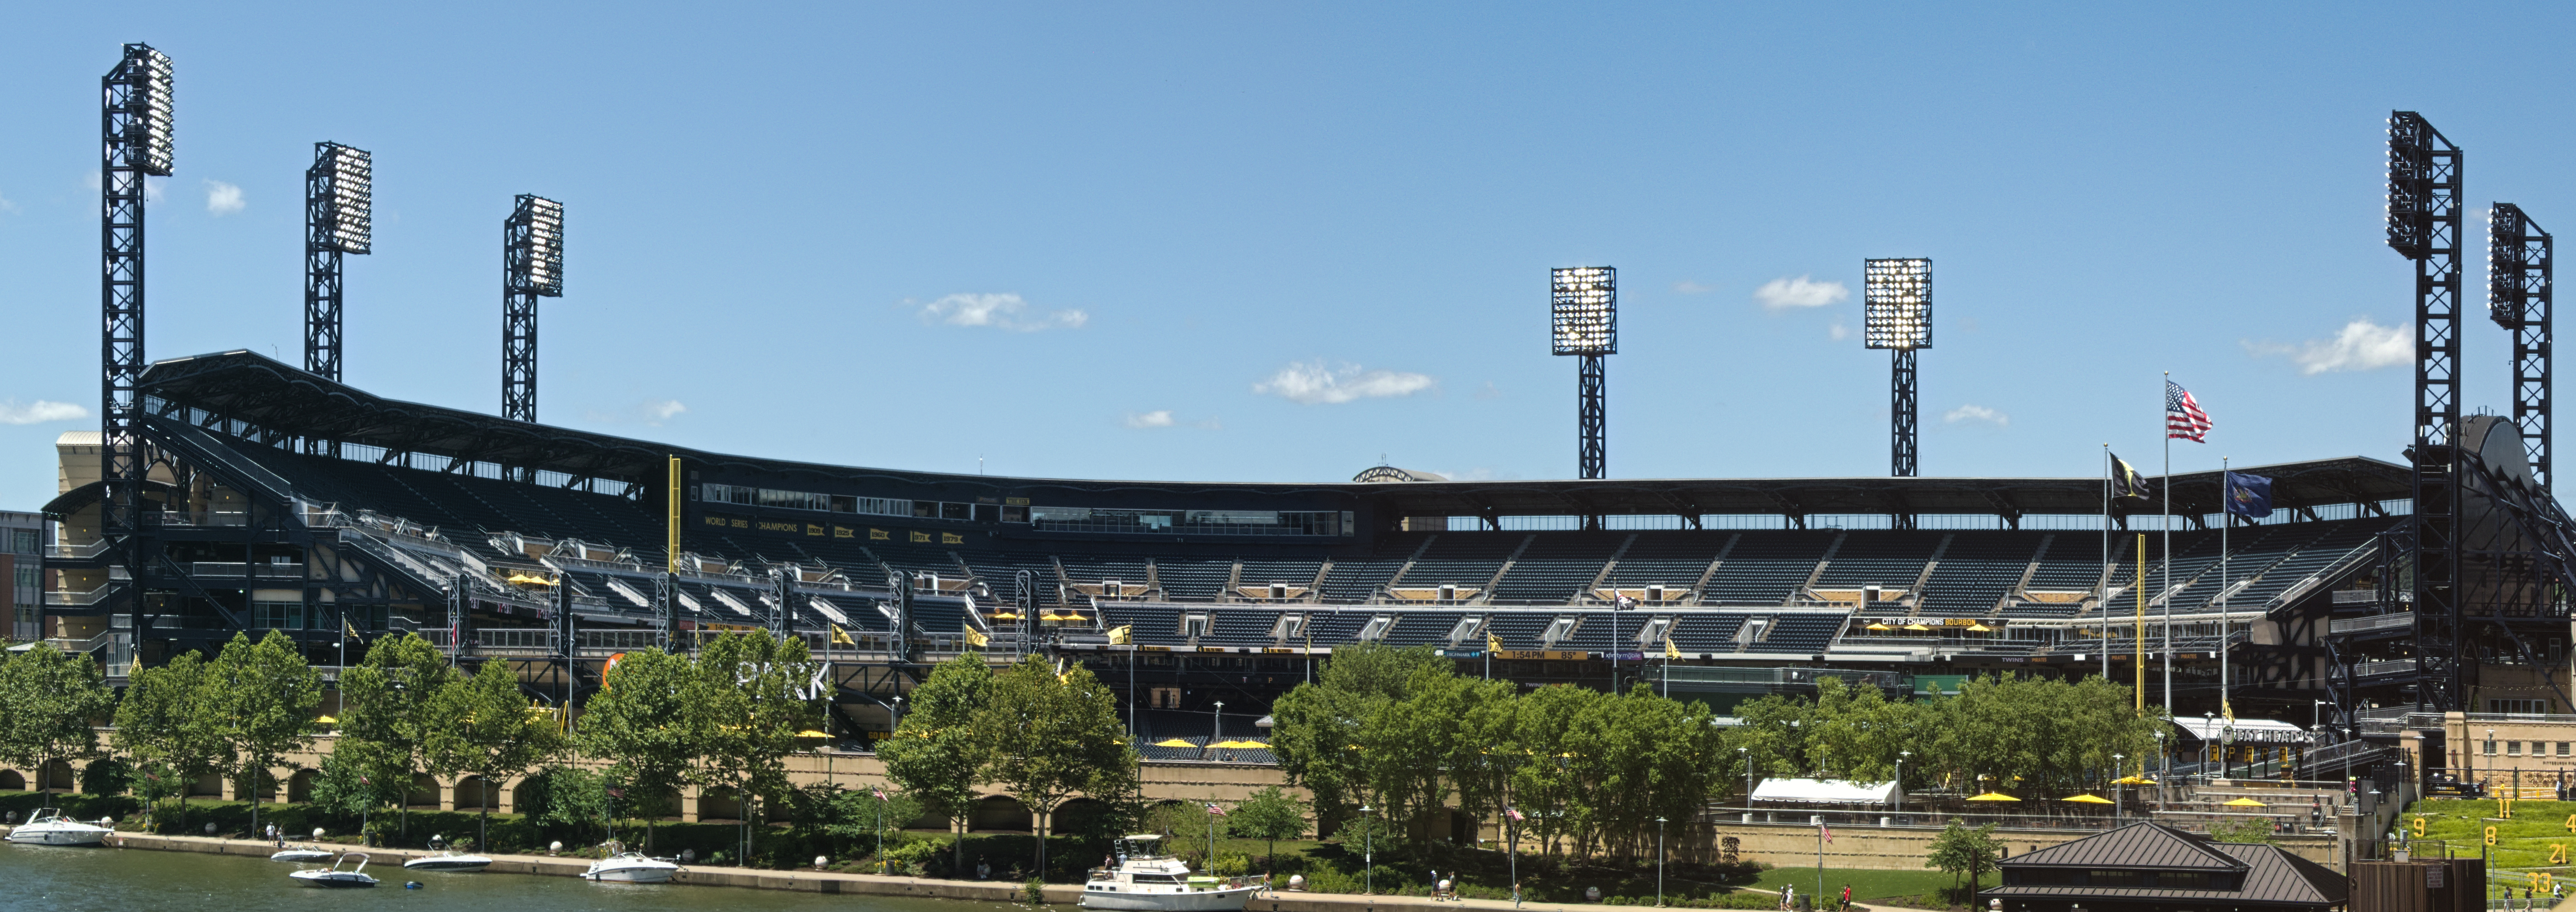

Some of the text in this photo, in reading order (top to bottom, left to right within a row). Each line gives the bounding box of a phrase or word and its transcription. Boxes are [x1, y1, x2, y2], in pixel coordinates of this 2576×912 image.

[705, 517, 797, 532] WORLD SERIES CHAMPIONS
[967, 629, 981, 643] 1971
[2237, 729, 2310, 743] FAT HEAD'S
[2211, 747, 2217, 758] P
[2228, 747, 2235, 759] P
[2246, 748, 2252, 759] P
[2261, 748, 2268, 759] P
[2279, 748, 2286, 760] P
[2296, 749, 2303, 760] P
[2498, 799, 2511, 819] 11
[2414, 818, 2425, 837] 9
[2485, 826, 2497, 846] 8
[2549, 844, 2567, 864] 21
[2527, 872, 2551, 892] 33
